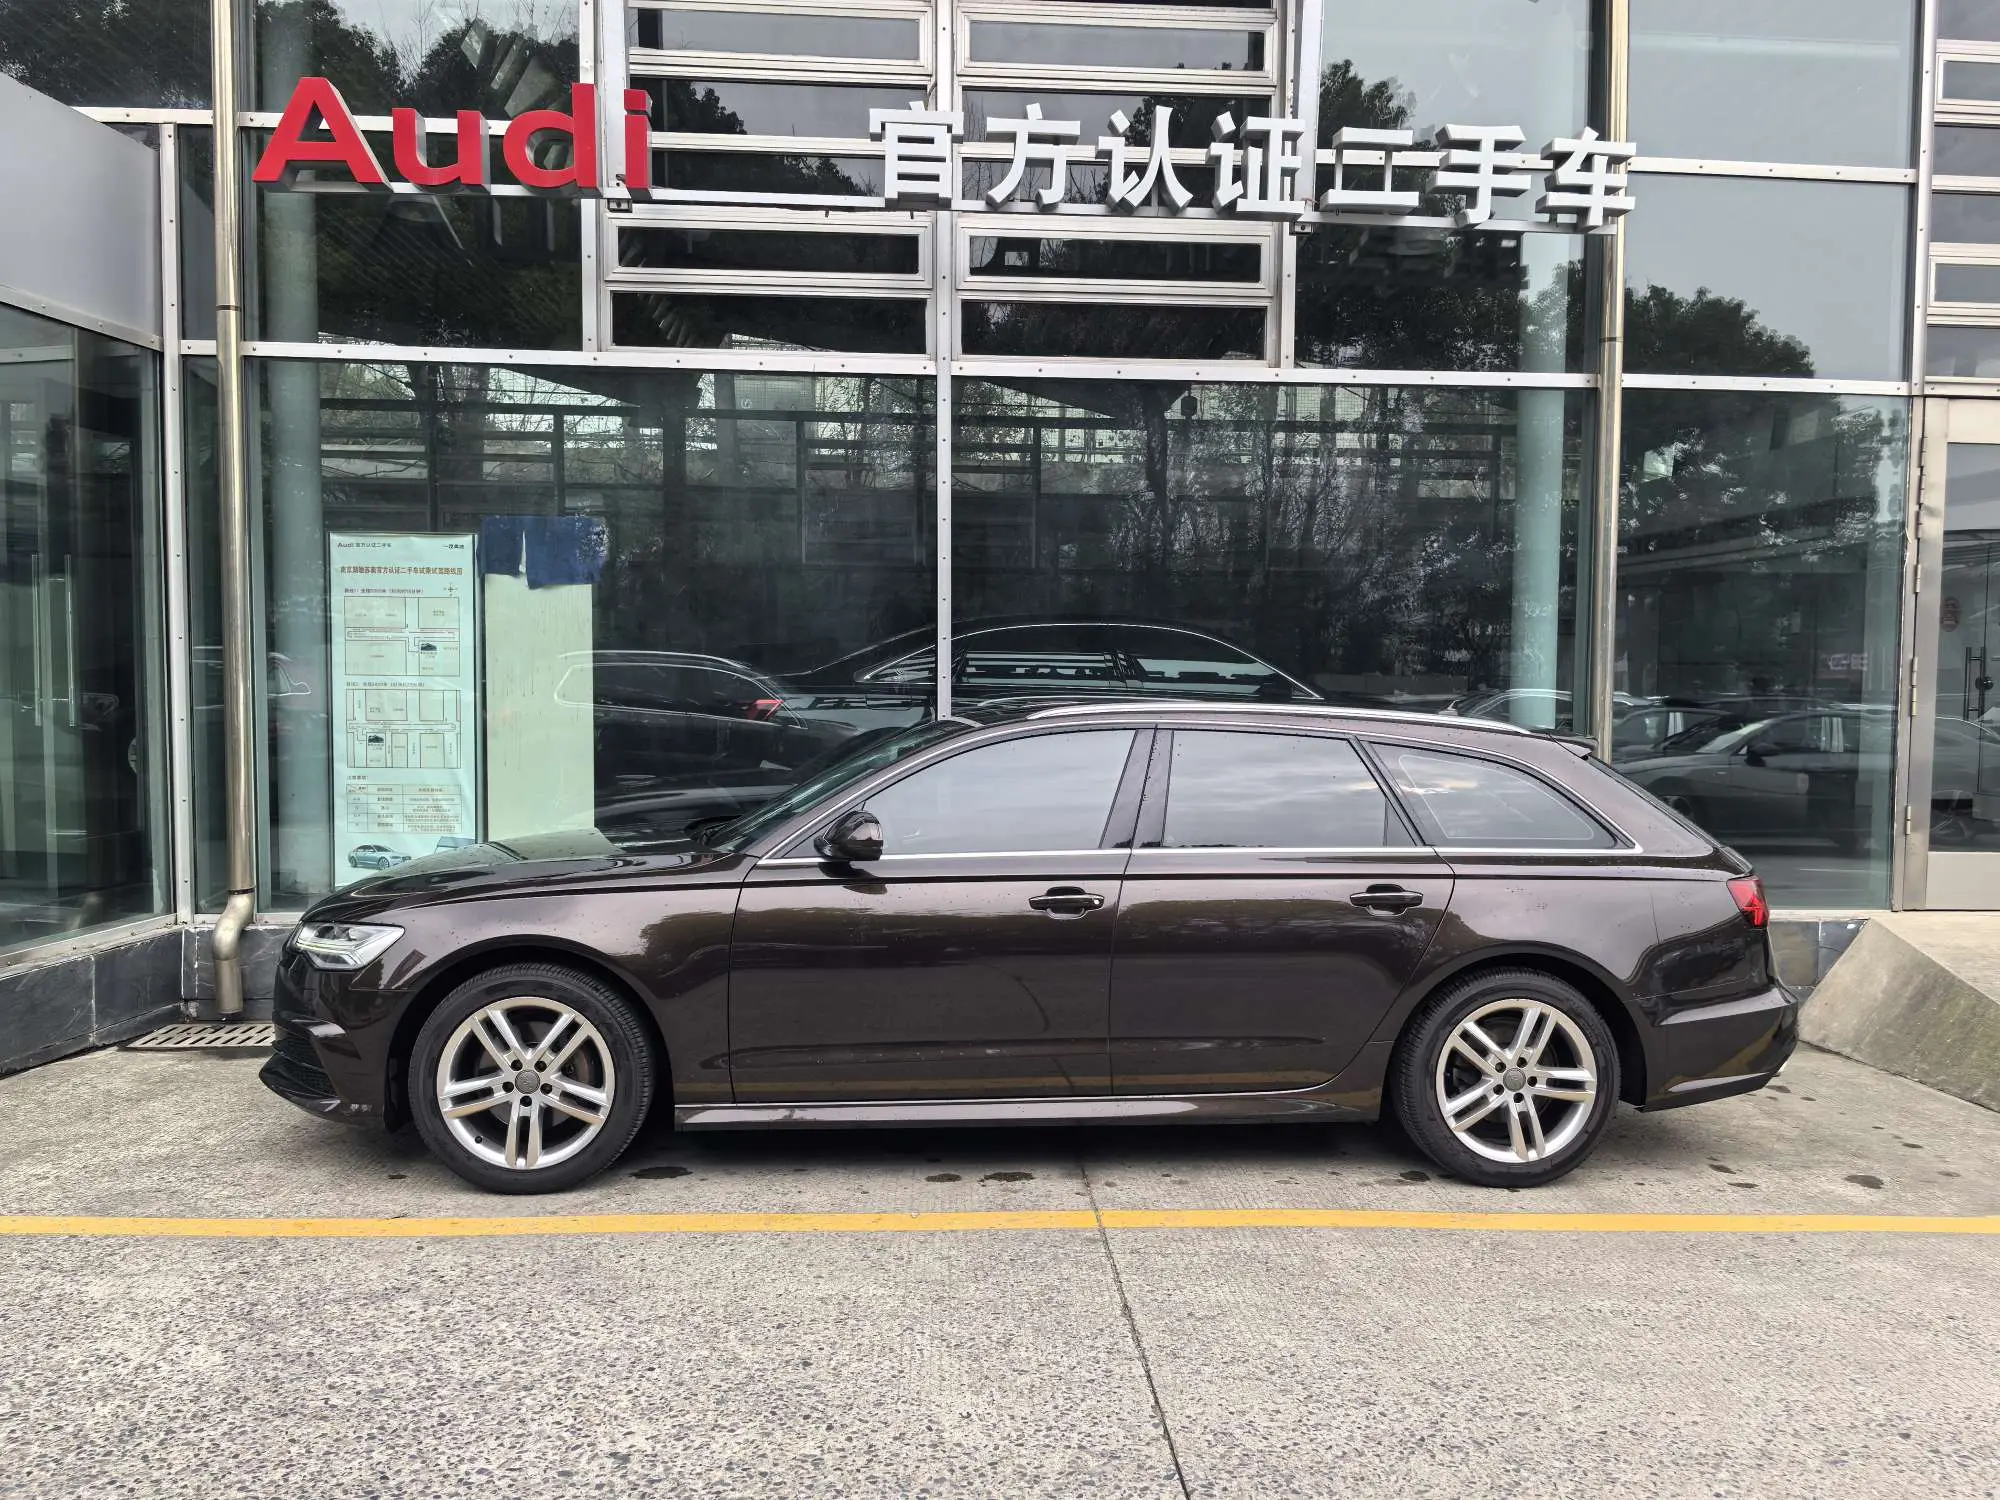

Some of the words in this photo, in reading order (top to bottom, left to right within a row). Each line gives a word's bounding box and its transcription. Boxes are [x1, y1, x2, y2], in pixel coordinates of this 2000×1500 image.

[252, 77, 652, 197] Audi
[869, 101, 1637, 233] 官方认证二手车
